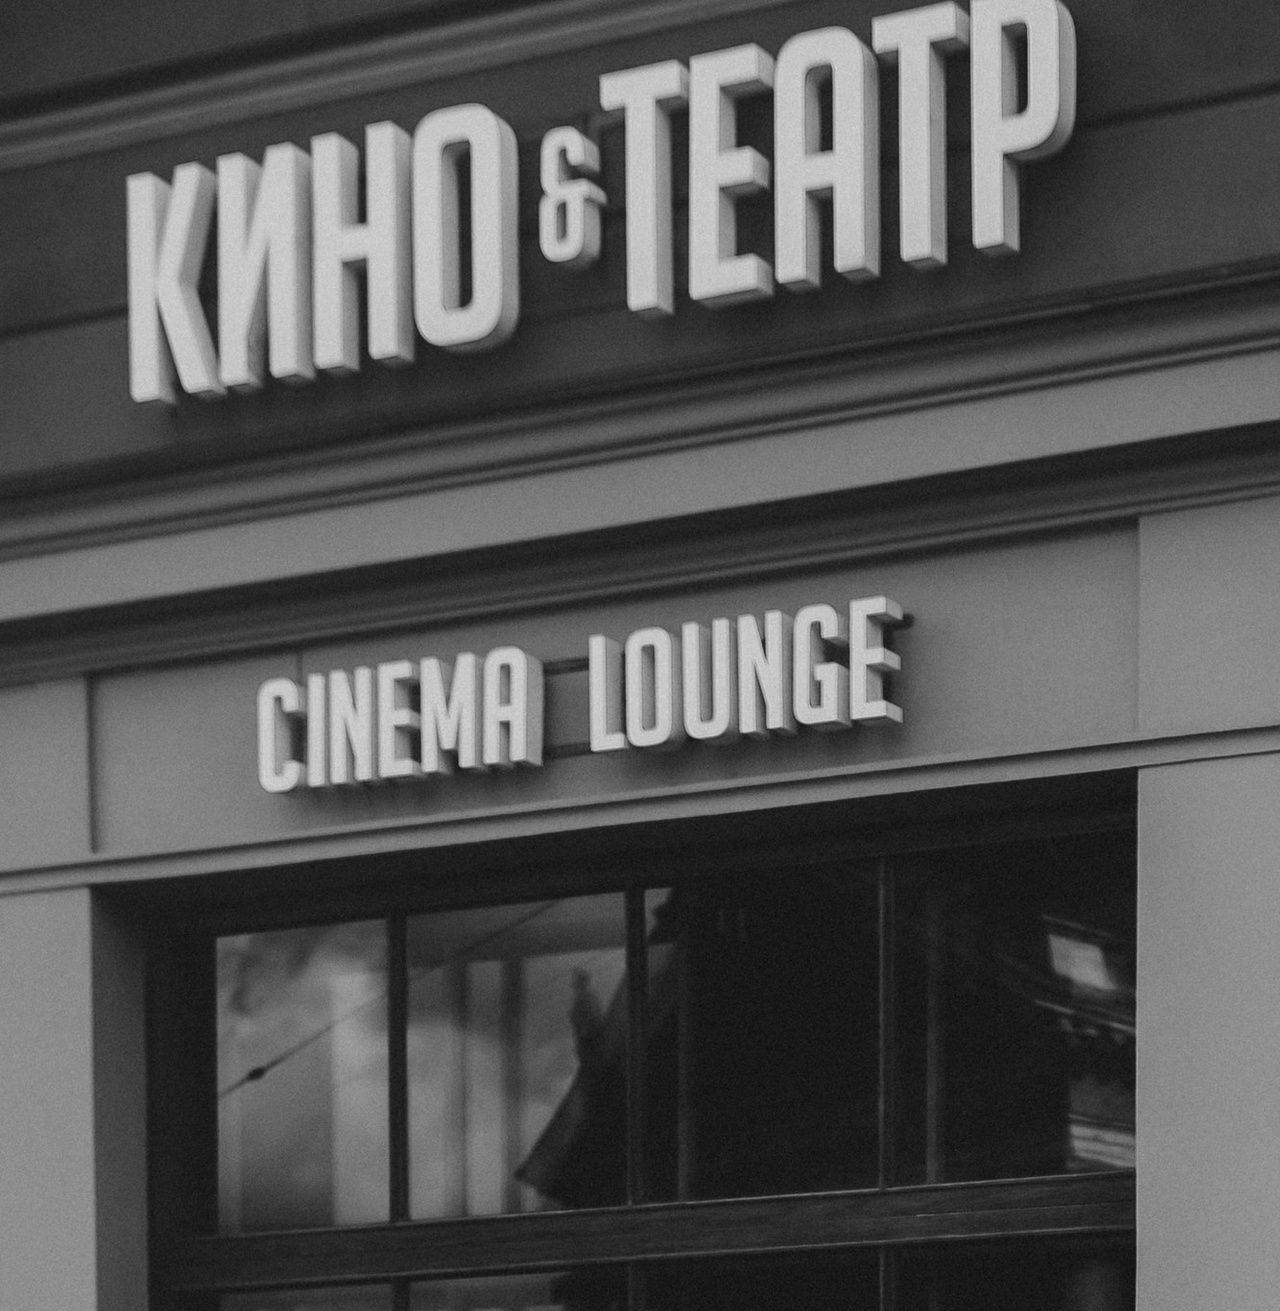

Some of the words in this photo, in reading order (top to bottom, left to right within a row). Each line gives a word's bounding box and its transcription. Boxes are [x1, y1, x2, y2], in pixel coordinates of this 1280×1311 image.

[126, 102, 520, 403] КИНО
[538, 126, 606, 264] &
[600, 0, 1077, 315] ТЕАТР
[256, 645, 544, 793] CINEMA
[588, 596, 904, 752] LOUNGE
